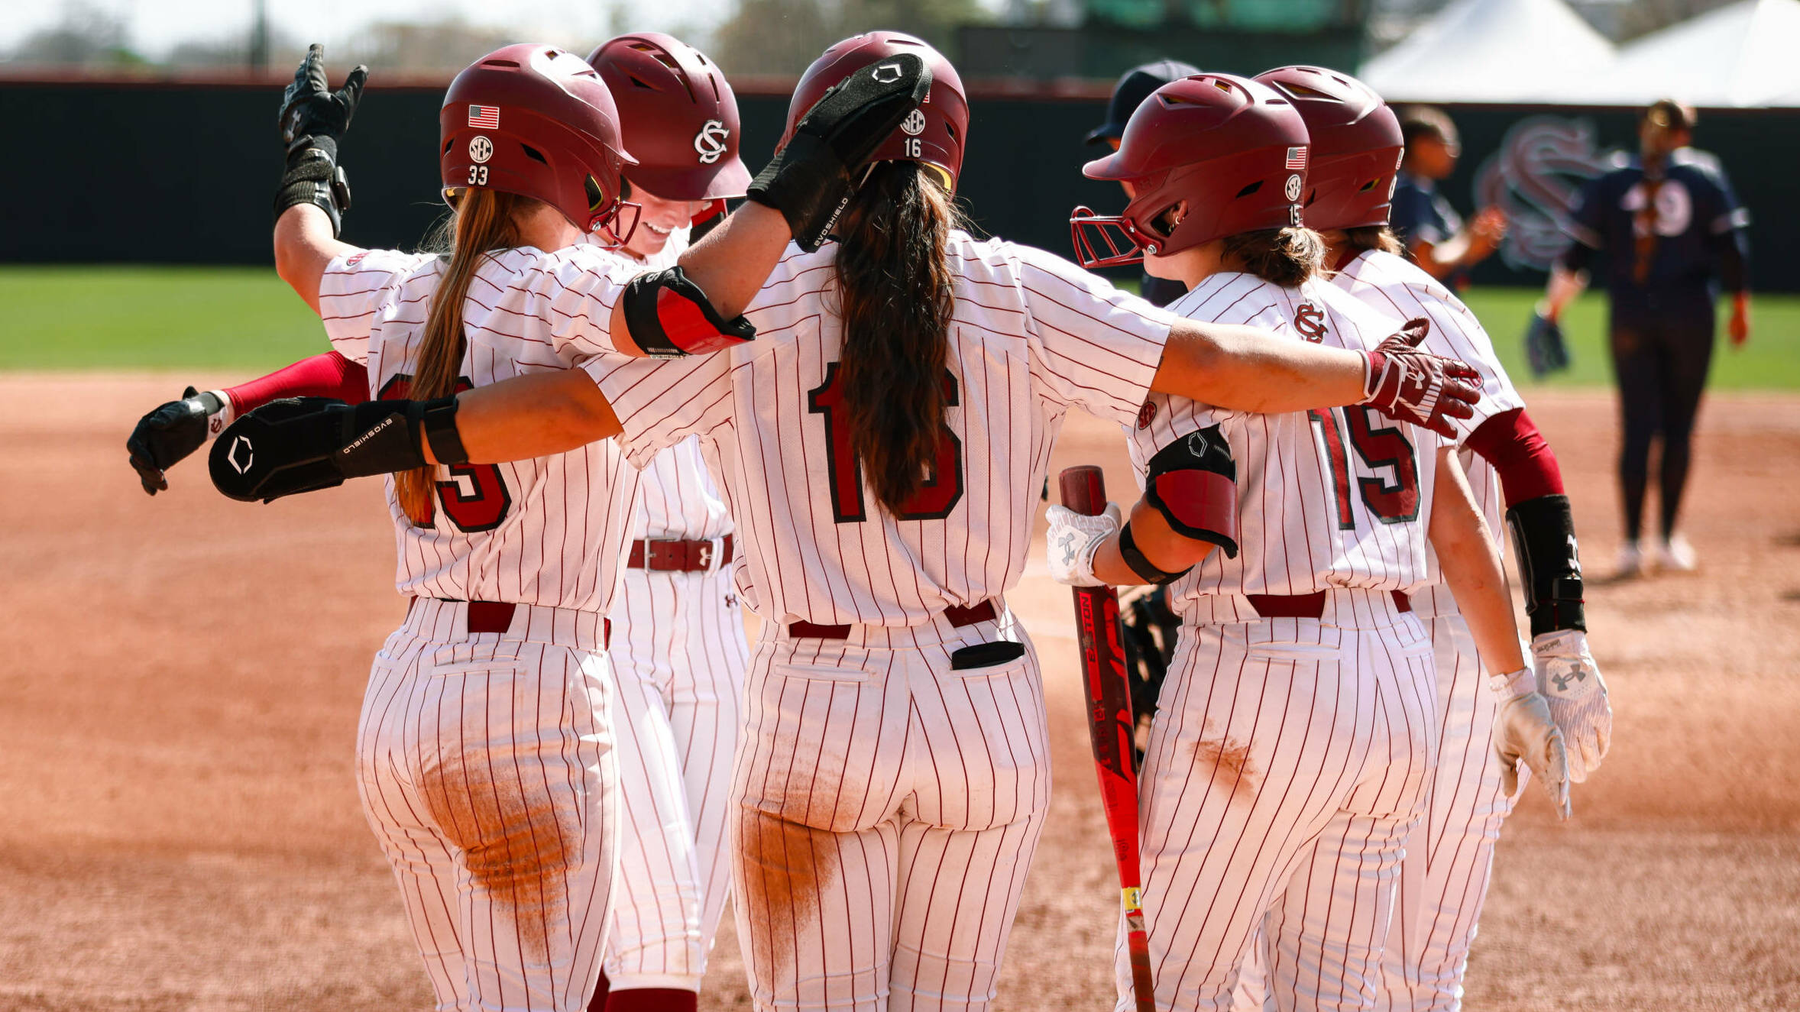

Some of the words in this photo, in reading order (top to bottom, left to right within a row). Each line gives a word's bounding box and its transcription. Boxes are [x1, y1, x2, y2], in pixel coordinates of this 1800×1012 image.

[471, 138, 492, 161] SEC
[904, 138, 921, 158] 16
[468, 165, 488, 186] 33
[814, 197, 849, 247] EVOSHIELD
[343, 418, 393, 454] EVOSHIELD
[1308, 404, 1421, 531] 15
